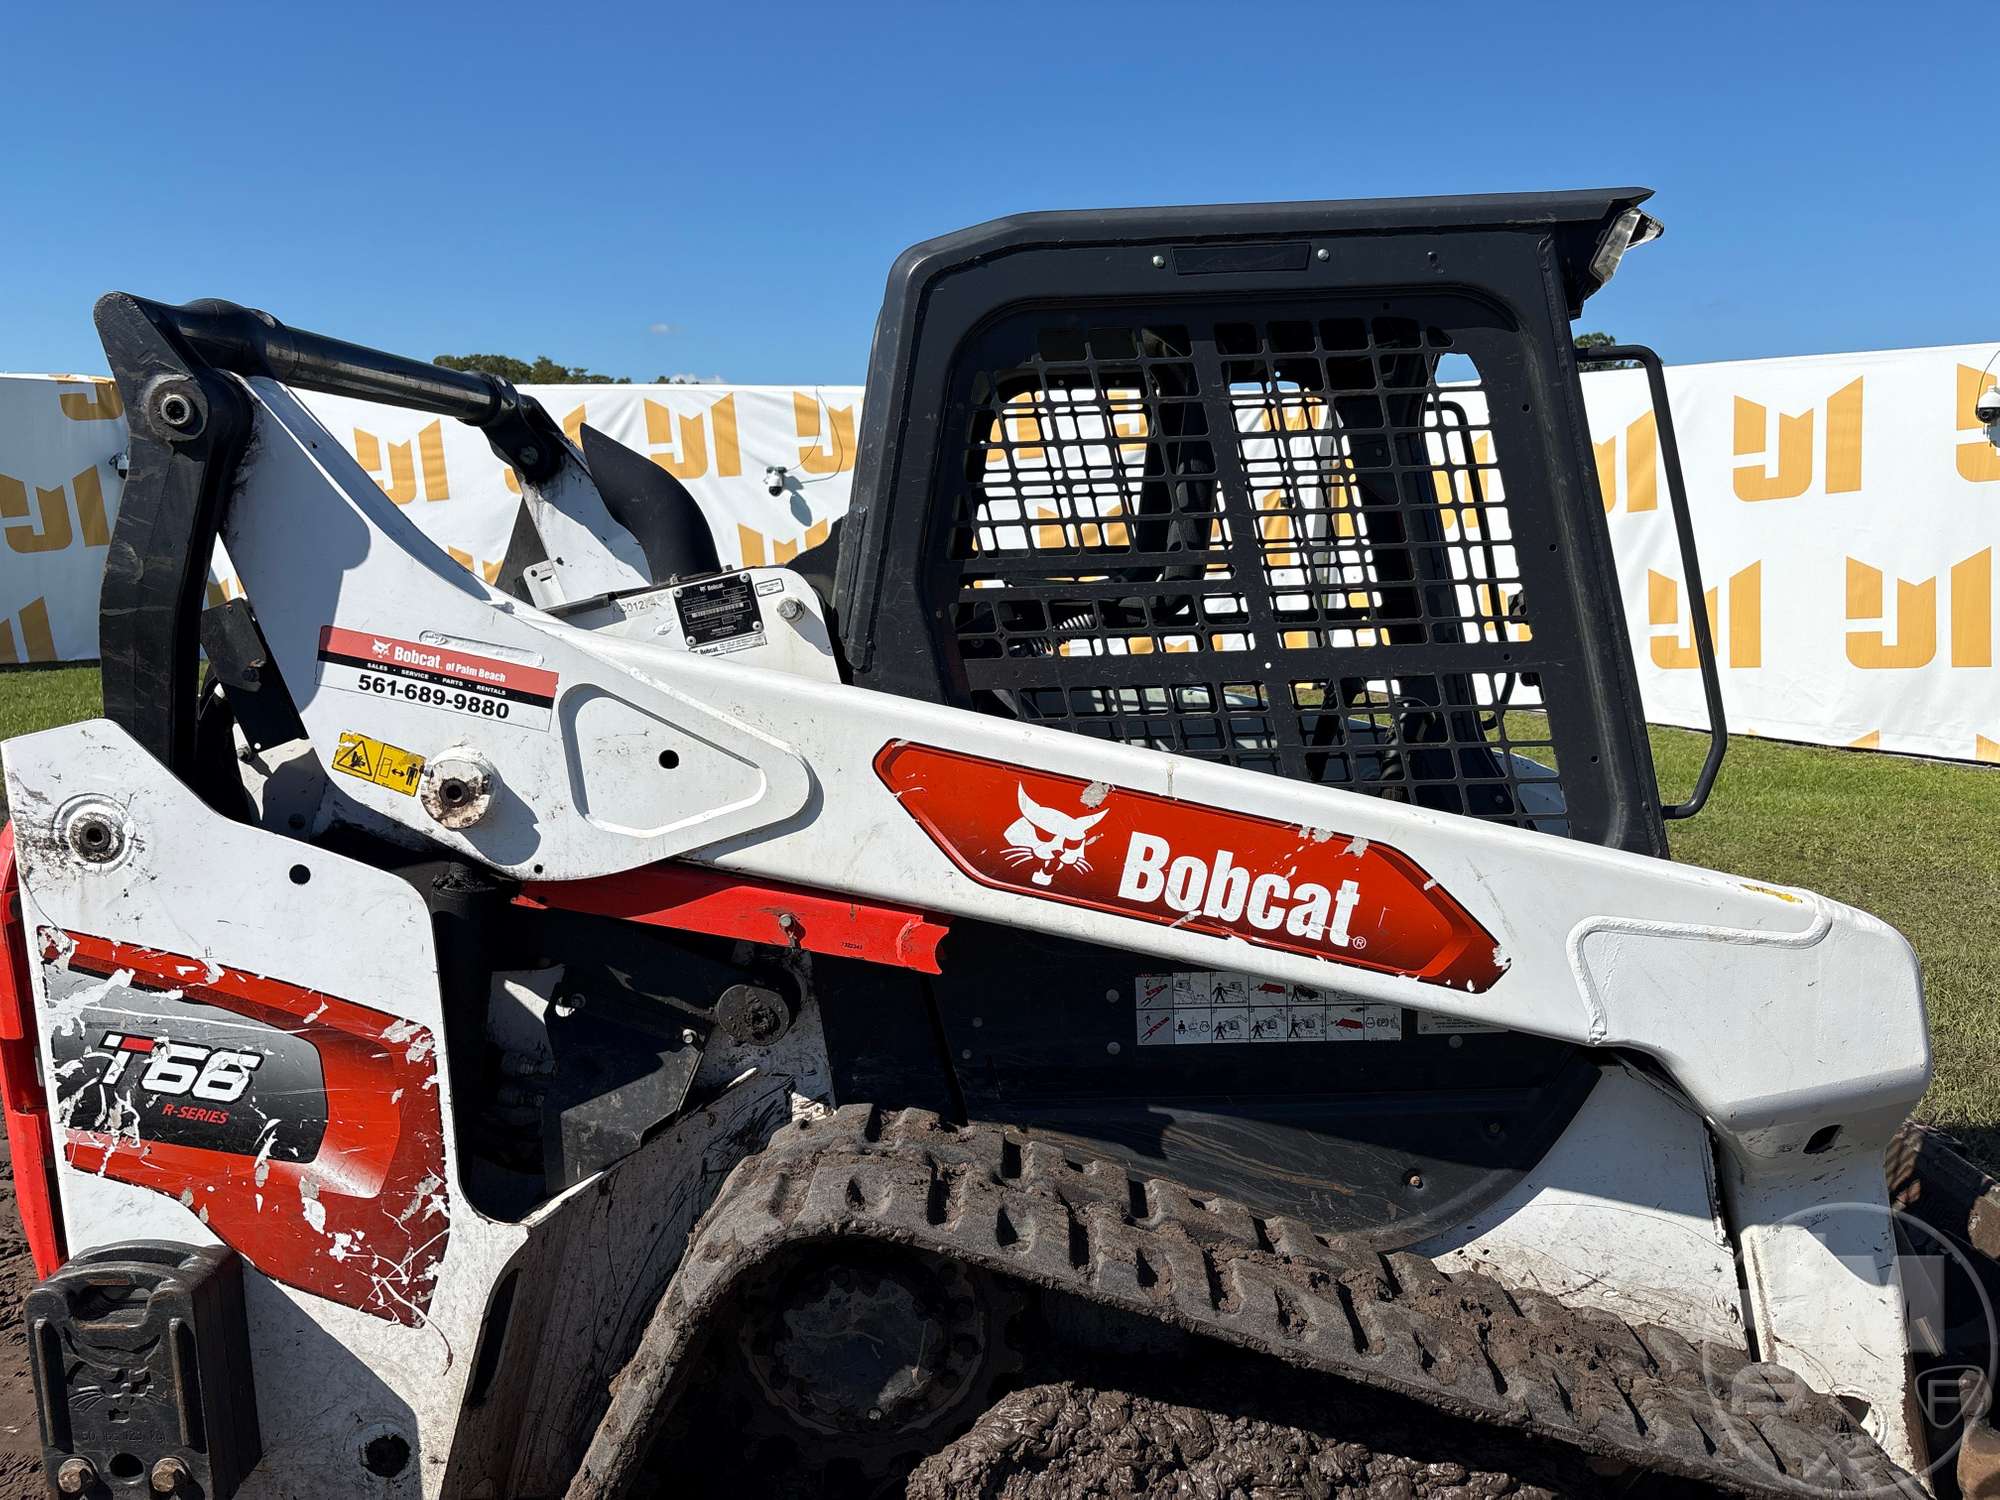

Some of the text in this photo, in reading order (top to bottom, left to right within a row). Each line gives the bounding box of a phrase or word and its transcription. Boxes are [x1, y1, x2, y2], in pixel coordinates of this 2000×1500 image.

[367, 662, 507, 696] SALES SERVICE PARTS RENTALS
[394, 646, 506, 683] Bobcat of Palm Beach
[358, 673, 510, 719] 561-689-9880
[99, 1031, 264, 1104] T66
[162, 1103, 230, 1125] R-SERIES
